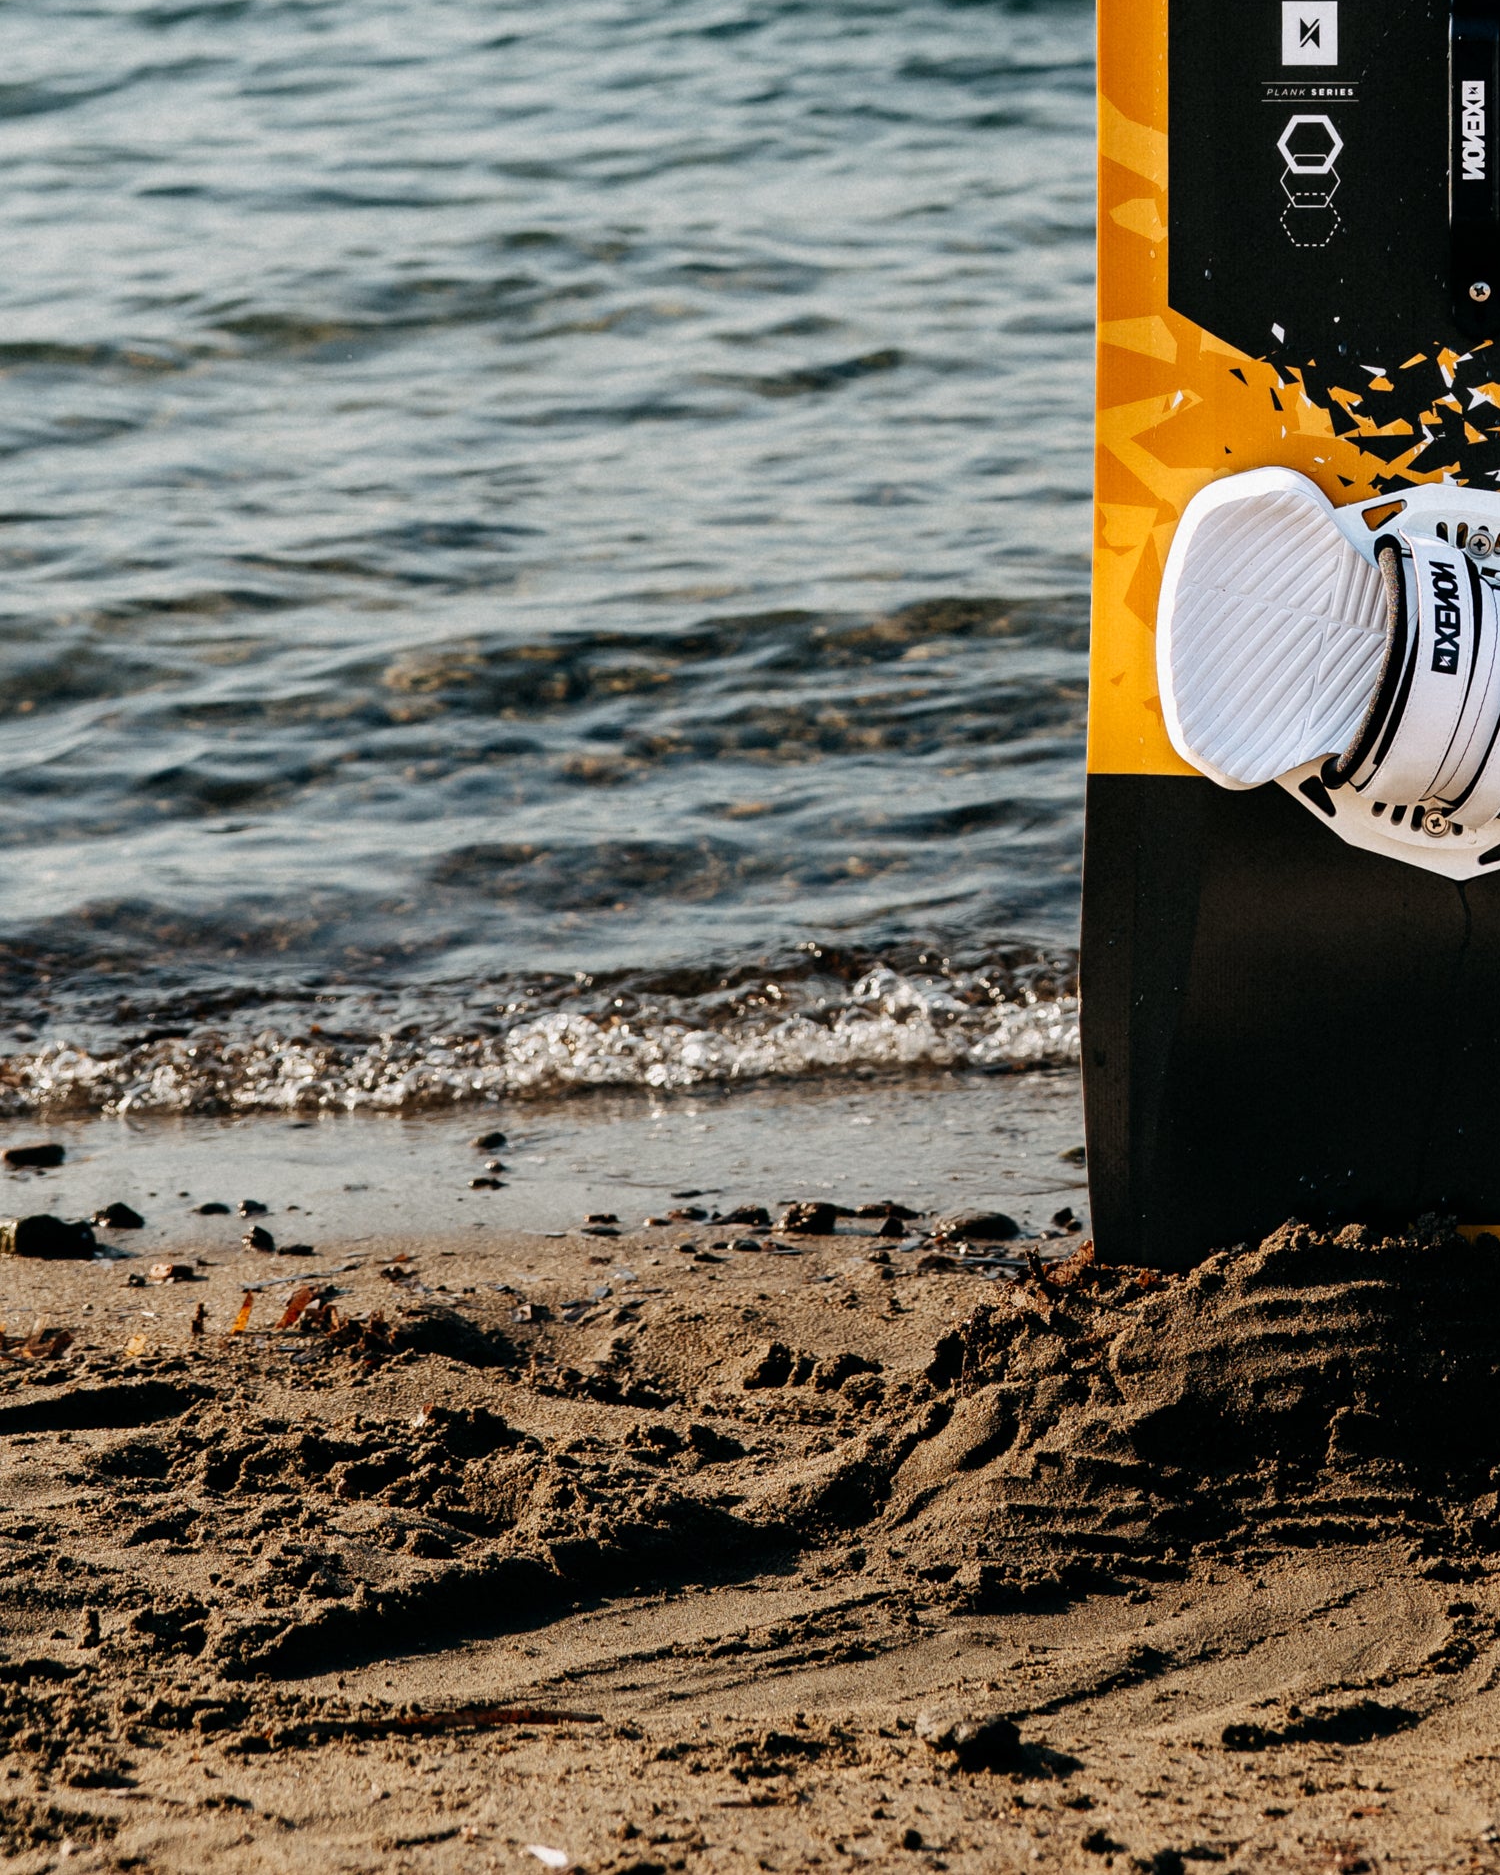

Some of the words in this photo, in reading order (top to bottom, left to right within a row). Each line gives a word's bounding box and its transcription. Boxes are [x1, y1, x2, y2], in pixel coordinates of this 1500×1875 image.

[1266, 88, 1306, 97] PLANK
[1311, 88, 1354, 97] SERIES
[1461, 98, 1486, 180] XENON
[1428, 560, 1461, 651] XENON
